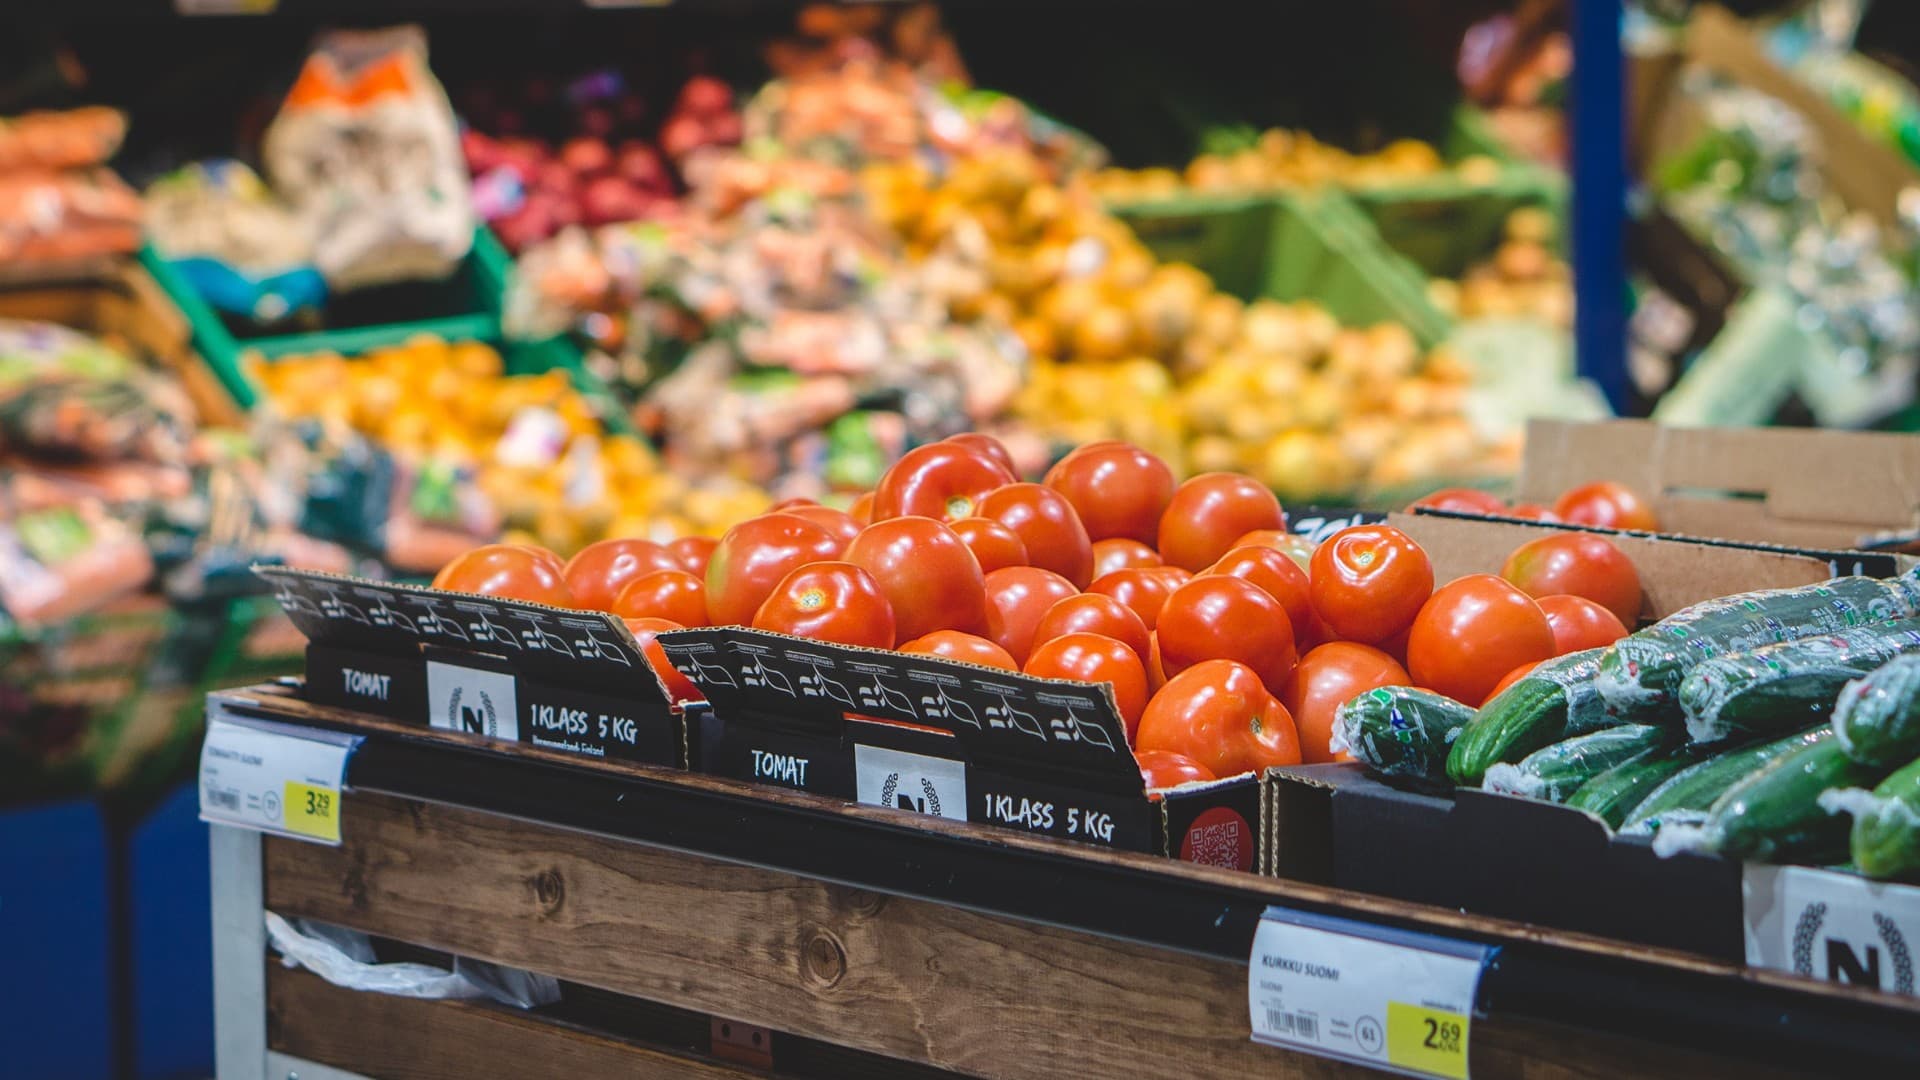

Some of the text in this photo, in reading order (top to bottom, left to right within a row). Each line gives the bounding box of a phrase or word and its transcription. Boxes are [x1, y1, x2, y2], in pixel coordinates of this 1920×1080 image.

[341, 668, 391, 701] TOMAT
[461, 705, 484, 735] N
[751, 749, 808, 786] TOMAT
[995, 793, 1054, 829] KLASS
[1261, 954, 1340, 982] KURKKU SUOMI
[1825, 936, 1880, 990] N
[1362, 1026, 1375, 1042] 61
